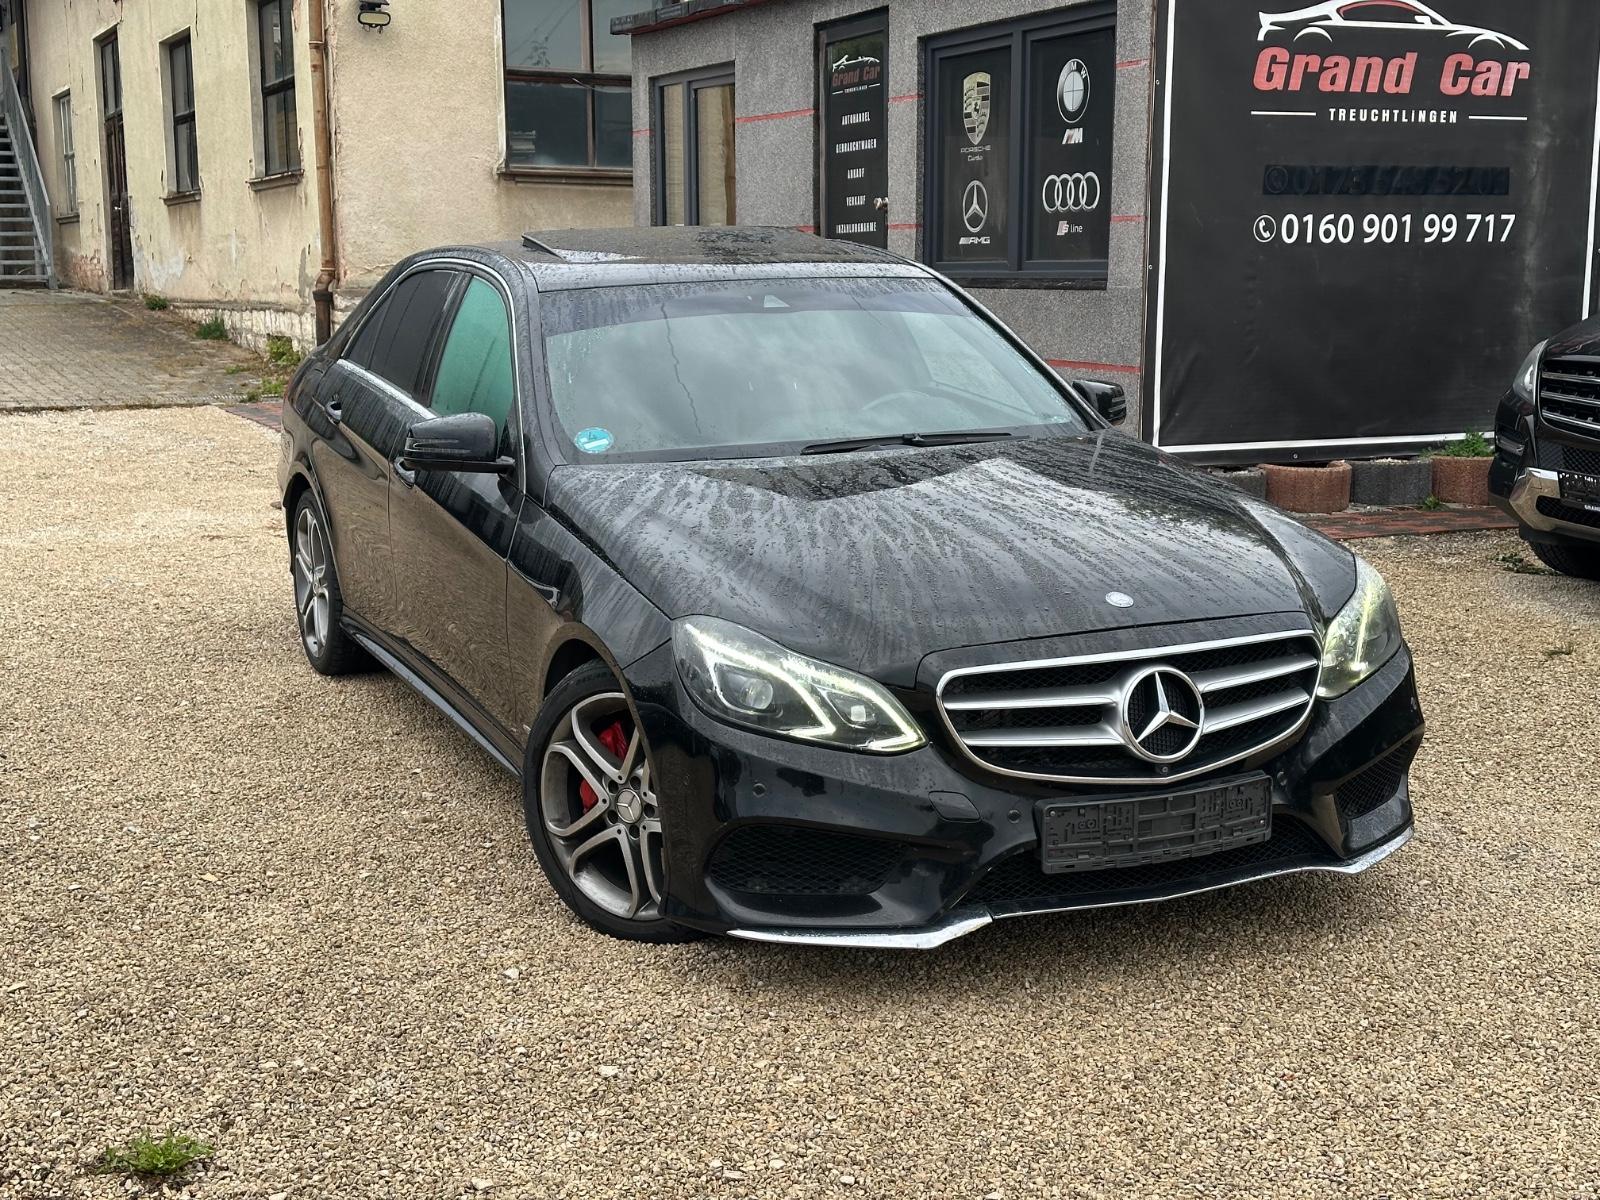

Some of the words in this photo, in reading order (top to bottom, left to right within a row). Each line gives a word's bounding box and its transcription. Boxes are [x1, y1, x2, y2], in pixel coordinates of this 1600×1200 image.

[832, 68, 860, 87] Grand
[863, 65, 880, 81] Car
[1252, 46, 1418, 95] Grand
[1439, 53, 1531, 97] Car
[1328, 107, 1458, 124] TREUCHTLINGEN
[1070, 223, 1084, 233] line
[1281, 213, 1355, 243] 0160
[1362, 213, 1411, 243] 901
[1423, 213, 1458, 243] 99
[1466, 213, 1516, 243] 717
